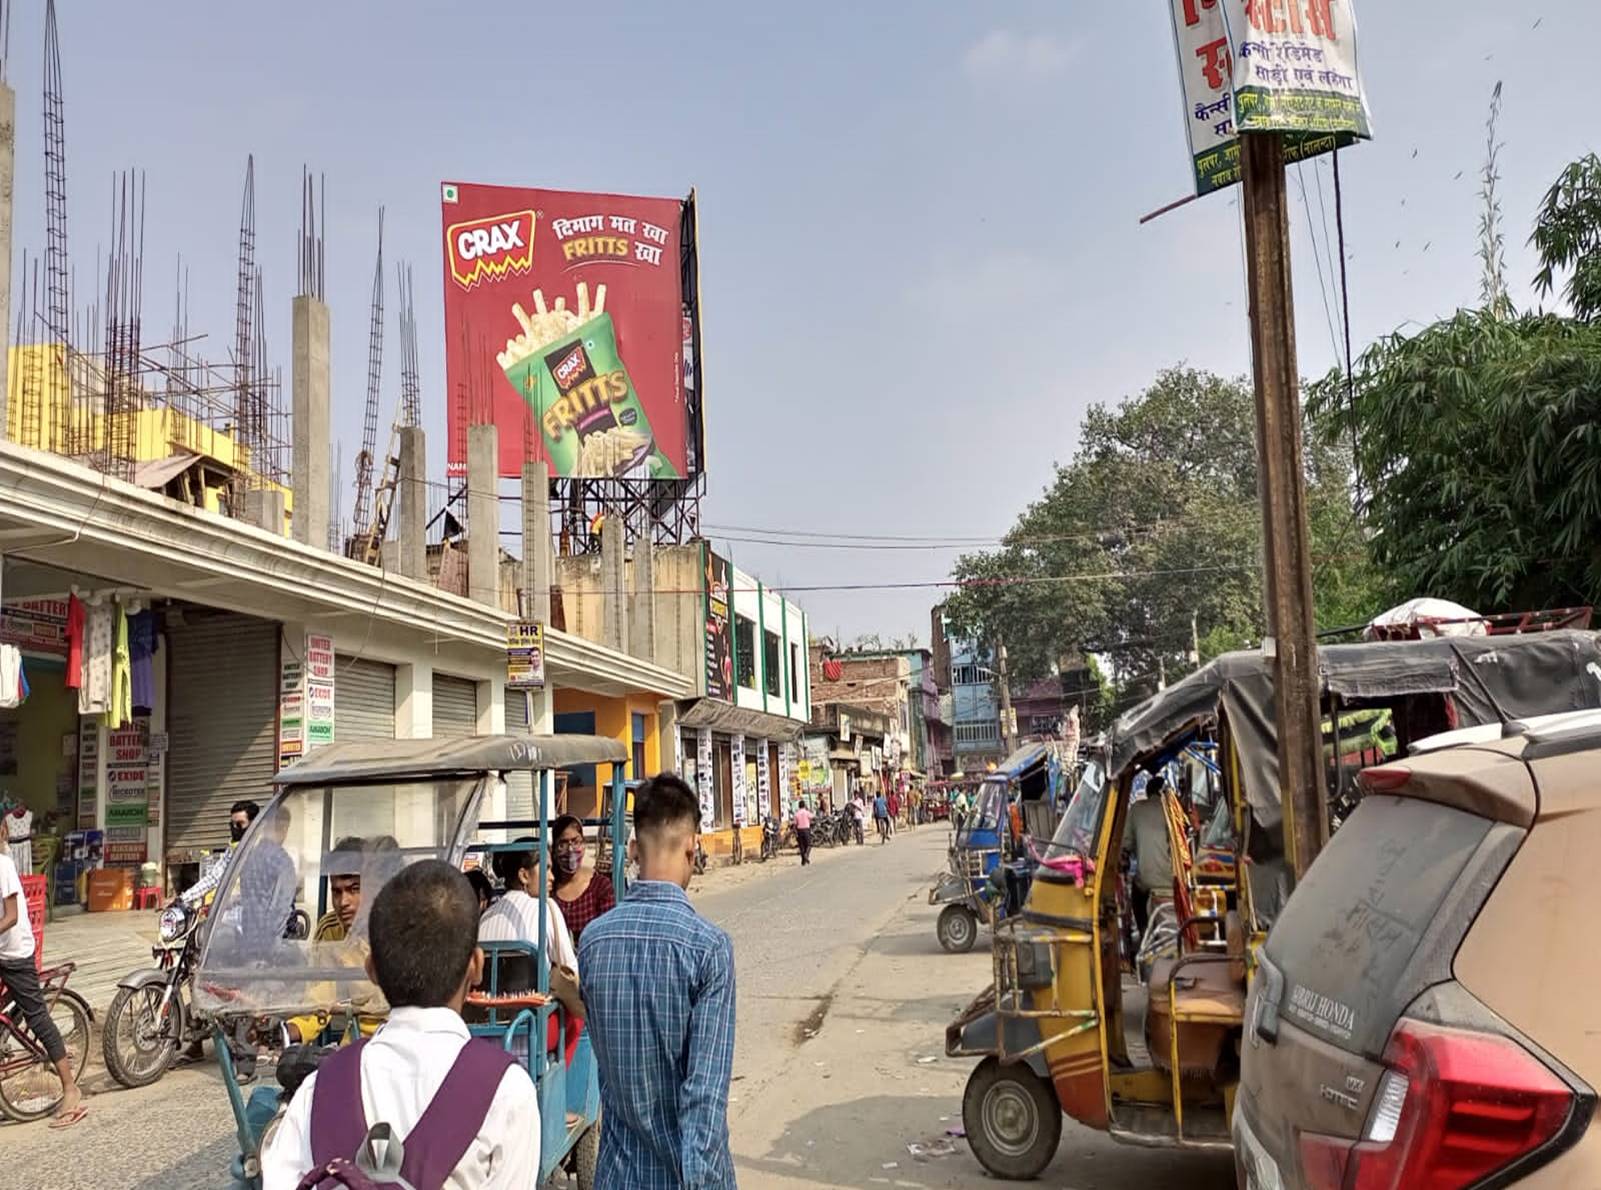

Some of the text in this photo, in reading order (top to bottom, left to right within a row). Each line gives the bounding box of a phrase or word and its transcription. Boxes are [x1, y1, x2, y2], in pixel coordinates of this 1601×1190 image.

[457, 220, 525, 260] CRAX
[552, 215, 669, 245] दिमाग मत खा
[562, 237, 628, 262] FRITTS
[634, 240, 663, 266] खा
[557, 351, 582, 379] CRAX
[542, 370, 629, 441] FRITTS
[22, 600, 67, 617] BATTER
[519, 625, 539, 637] HR
[117, 770, 145, 782] EXIDE
[1317, 997, 1354, 1030] HONDA
